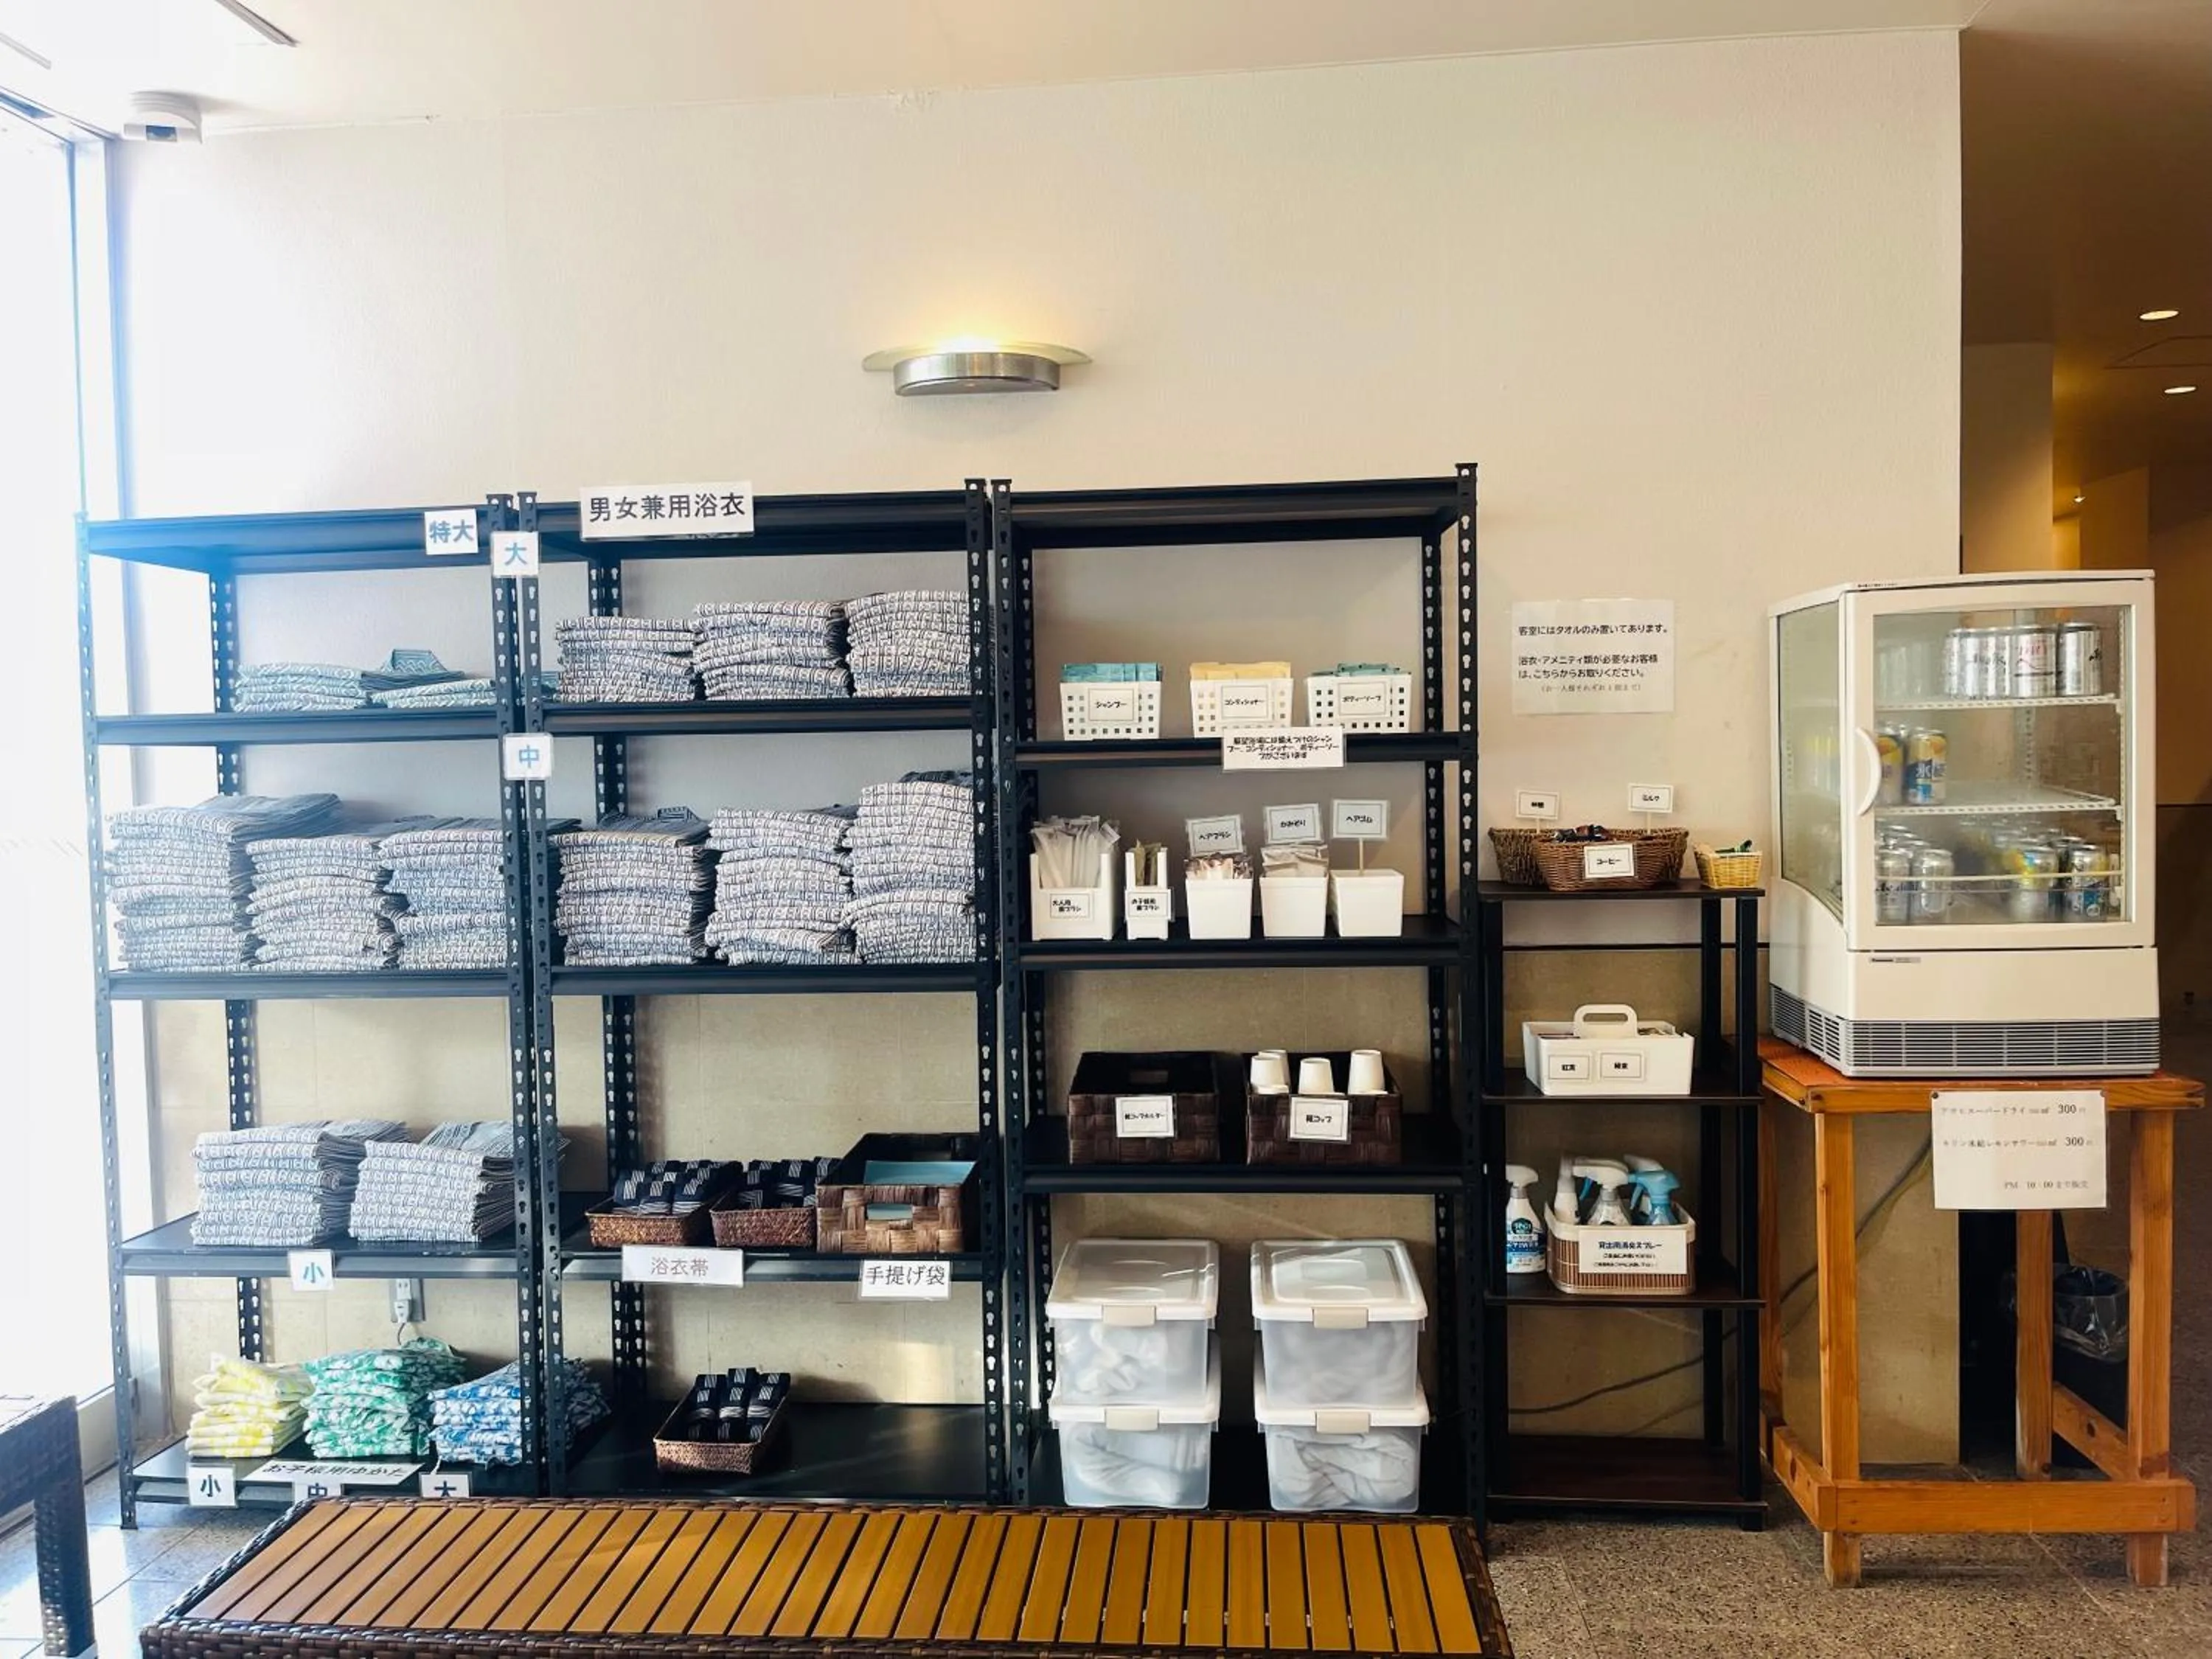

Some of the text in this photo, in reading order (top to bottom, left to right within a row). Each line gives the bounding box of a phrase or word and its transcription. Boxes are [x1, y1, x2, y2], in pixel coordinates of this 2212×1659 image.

[589, 493, 745, 522] 男女兼用浴衣
[429, 519, 474, 543] 特大
[504, 542, 527, 566] 大
[518, 745, 540, 768] 中
[303, 1262, 324, 1284] 小
[650, 1257, 709, 1277] 浴衣帯
[866, 1265, 945, 1286] 手提げ袋
[200, 1474, 221, 1498] 小
[307, 1482, 328, 1498] 中
[434, 1480, 457, 1497] 大
